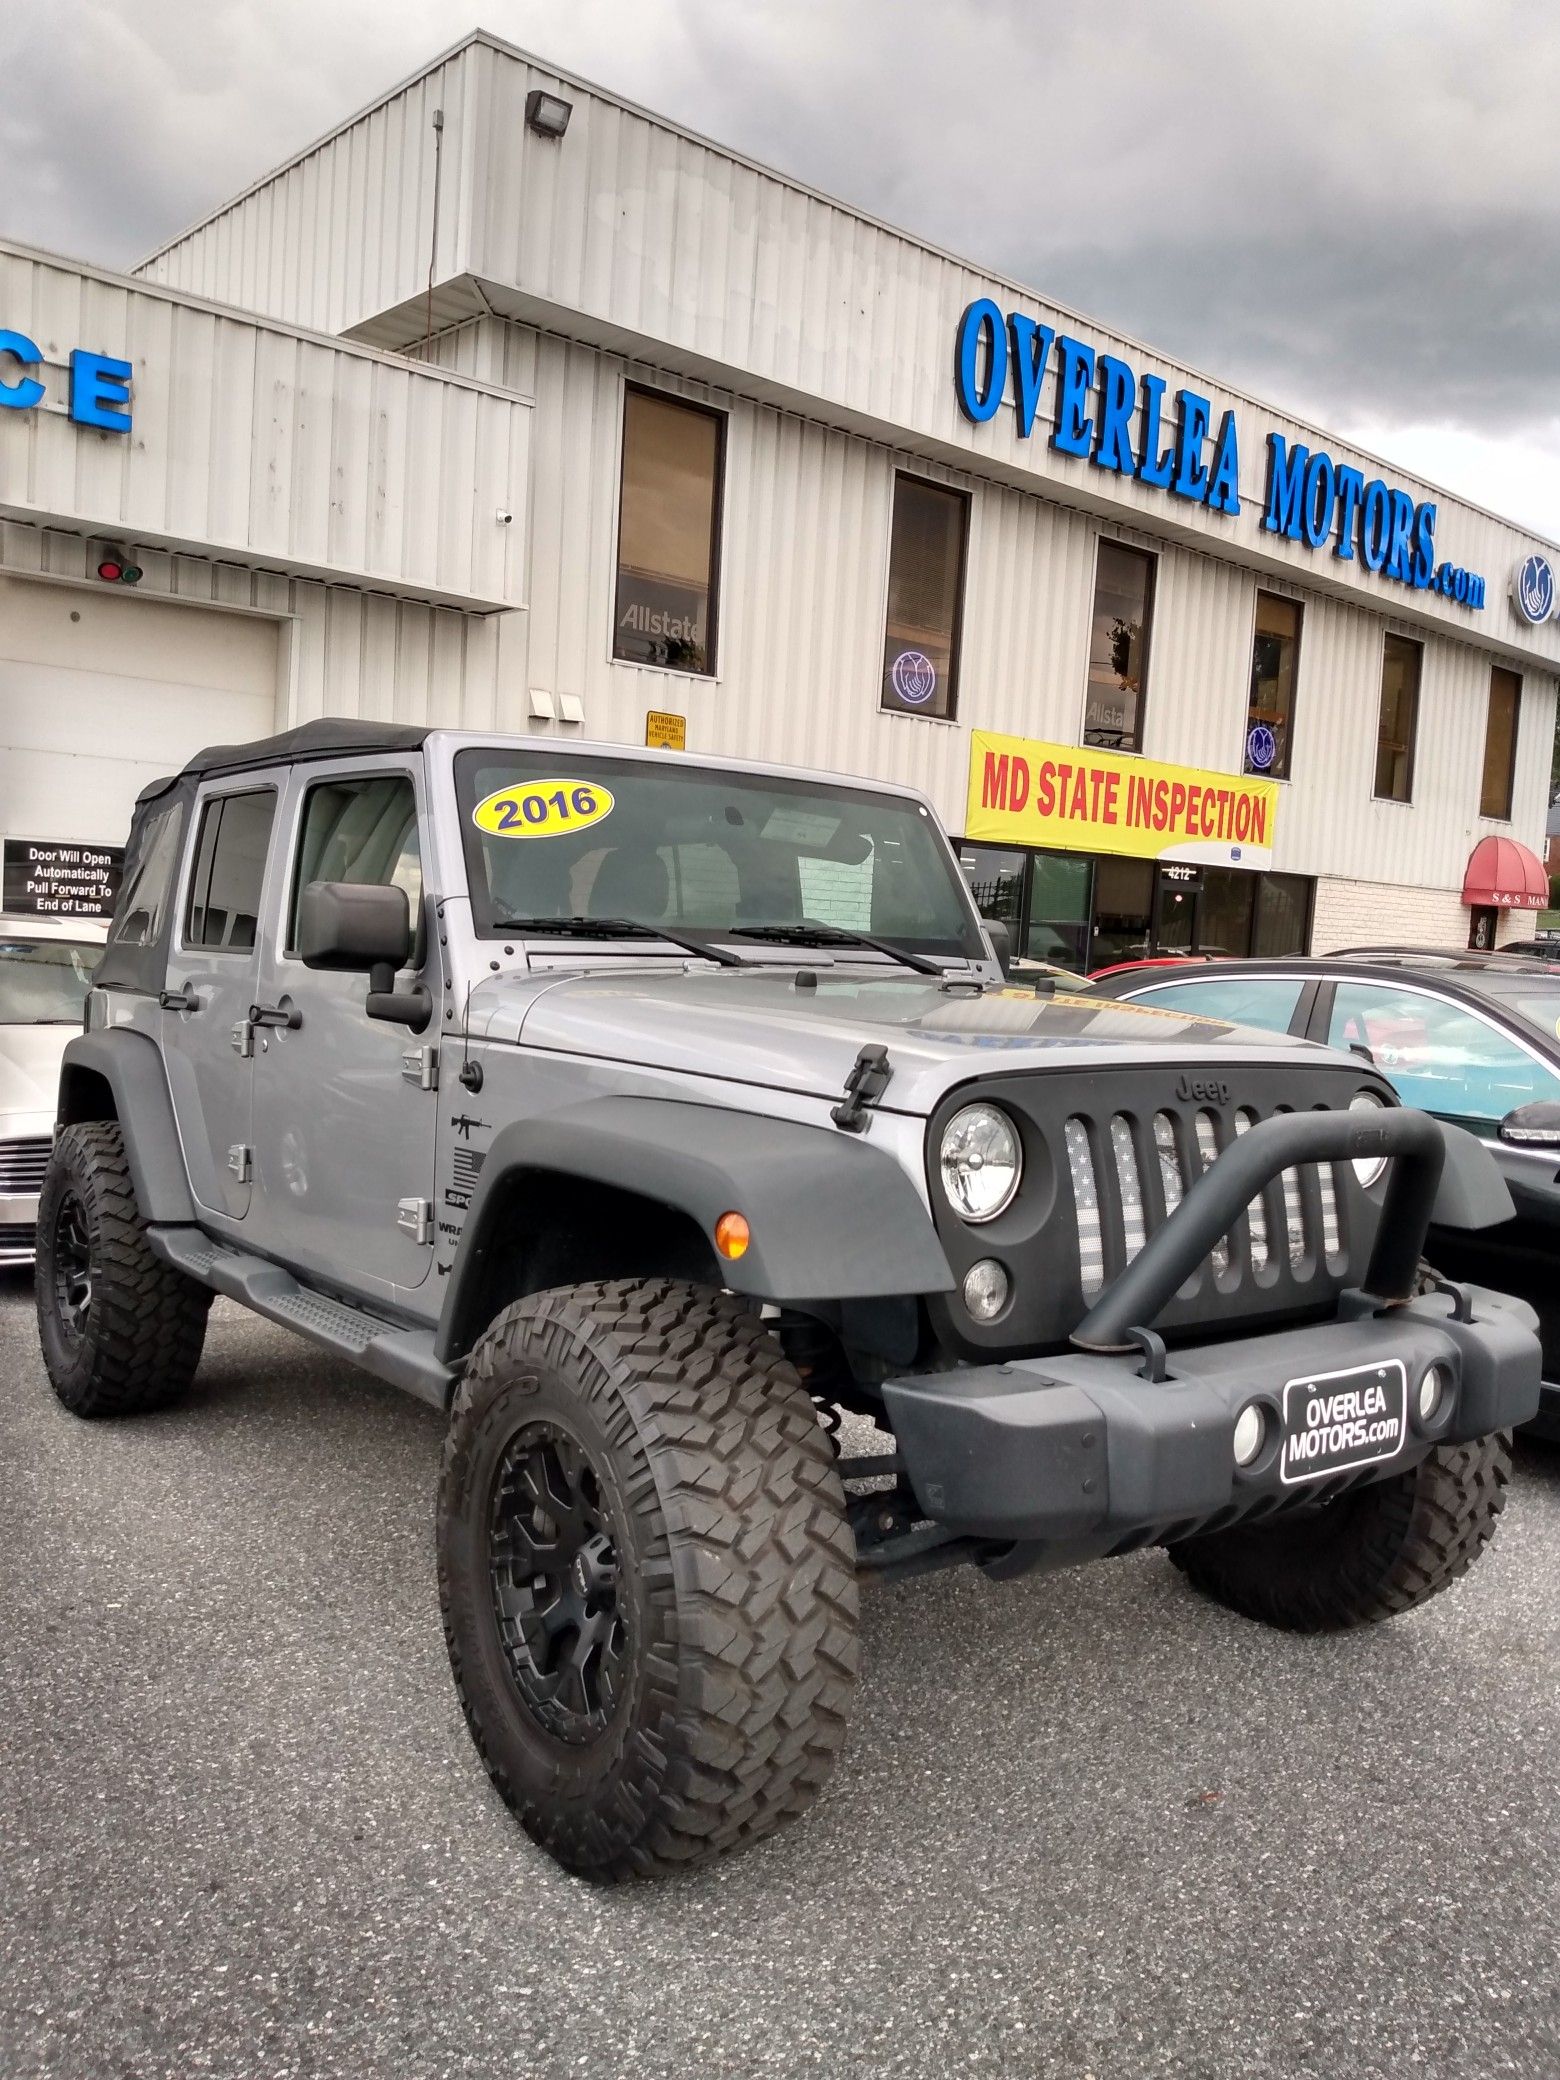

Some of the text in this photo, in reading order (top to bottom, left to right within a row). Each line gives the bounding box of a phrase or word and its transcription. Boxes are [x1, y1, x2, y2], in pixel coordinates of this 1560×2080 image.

[954, 297, 1487, 610] OVERLEA MOTORS.com
[494, 788, 597, 830] 2016
[982, 752, 1267, 844] MD STATE INSPECTION
[29, 848, 112, 866] Door Will Open
[27, 881, 112, 897] Pull Forward To
[34, 865, 109, 883] Automatically
[37, 898, 102, 913] End of Lane
[1492, 893, 1500, 903] S
[1502, 894, 1512, 903] &
[1513, 895, 1521, 904] S
[1175, 1073, 1231, 1106] Jeep
[1306, 1386, 1387, 1428] OVERLEA
[1289, 1418, 1399, 1462] MOTORS.com
